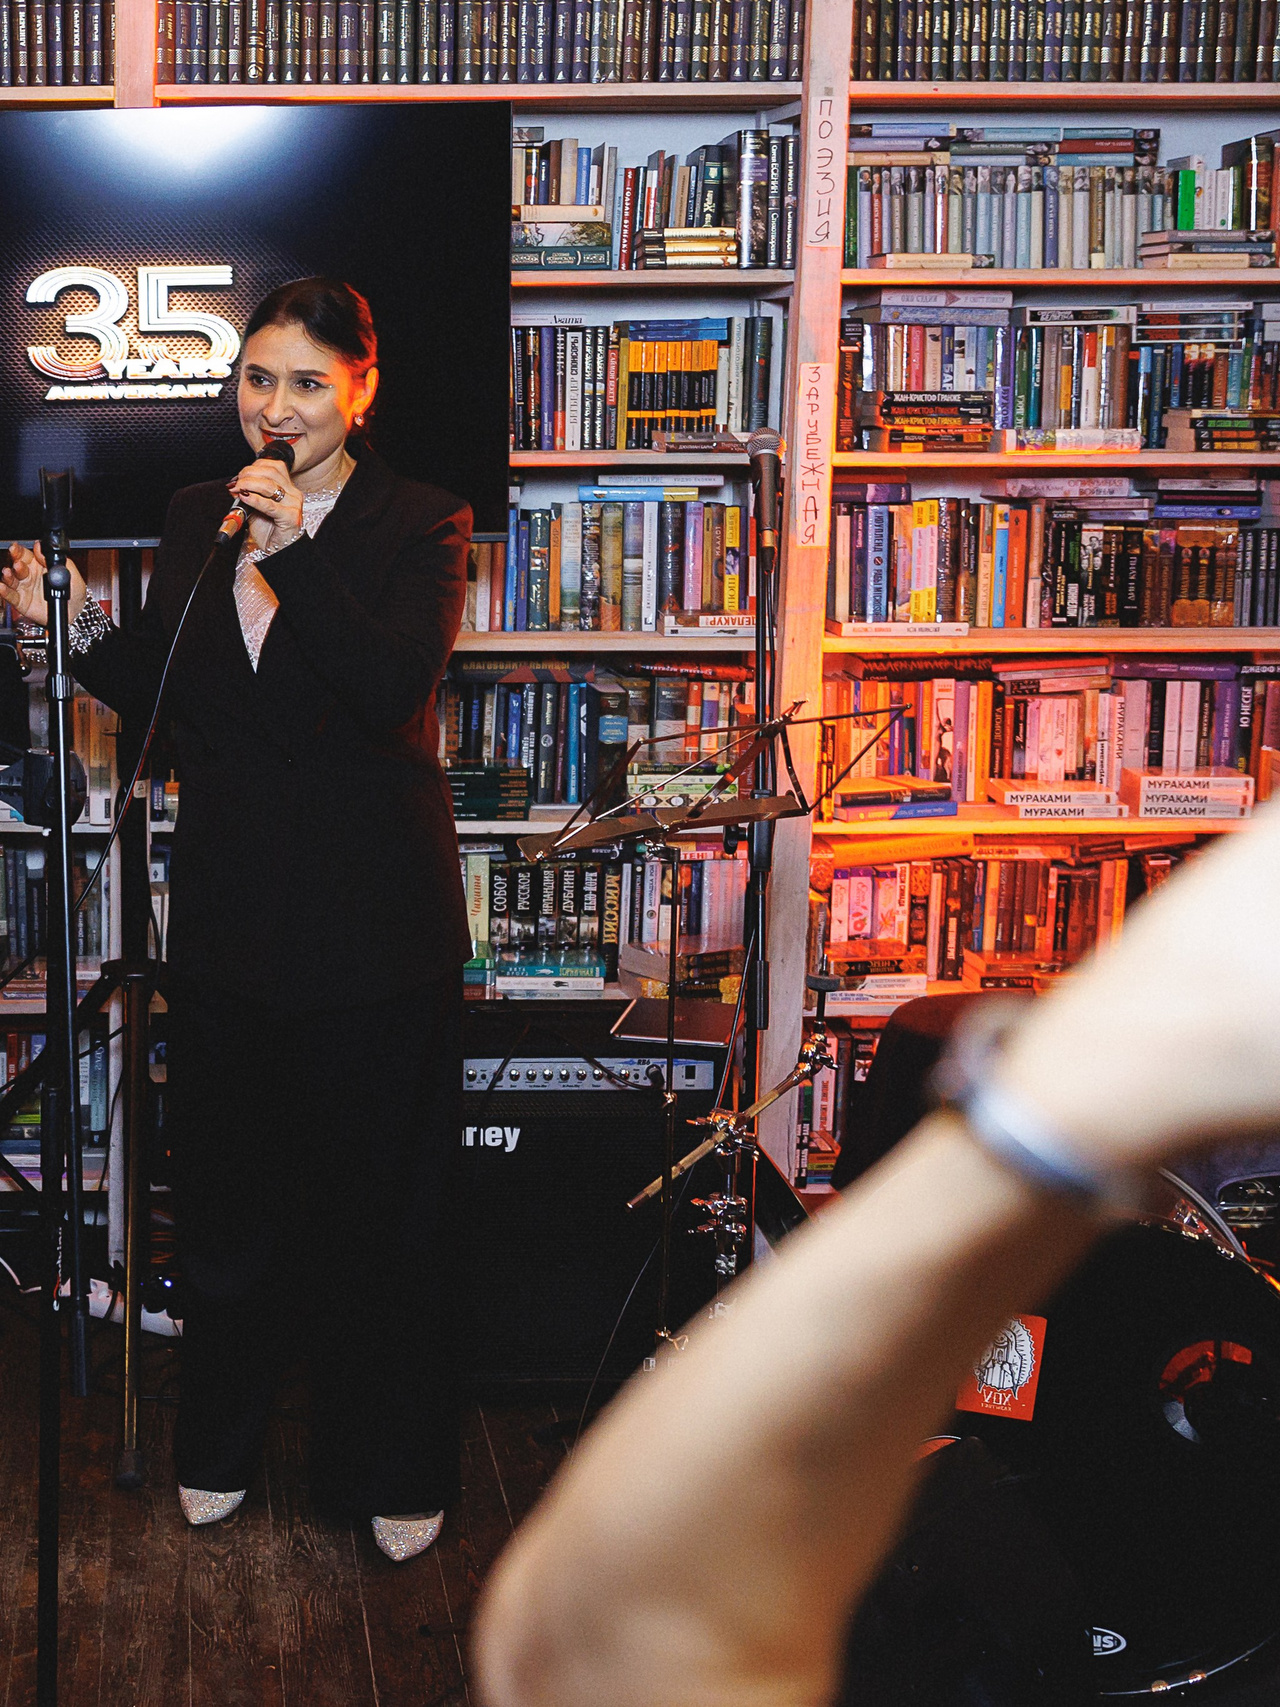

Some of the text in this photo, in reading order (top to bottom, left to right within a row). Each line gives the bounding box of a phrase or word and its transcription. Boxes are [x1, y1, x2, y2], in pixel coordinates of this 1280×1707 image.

[770, 163, 780, 193] ЕСЕНИН
[808, 100, 835, 243] ПОЭЗИЯ
[26, 265, 241, 380] 35
[101, 357, 232, 379] YEARS
[570, 336, 579, 375] СПОНСОРЫ
[44, 383, 223, 400] ANNIVERSARY
[609, 352, 618, 402] САЙМОН БЕКЕТТ
[891, 406, 934, 414] ЖАН-КРИСТОФ
[893, 393, 961, 402] ЖАН-КРИСТОФ ГРАНЖЕ
[893, 417, 962, 425] ЖАН-КРИСТОФ ГРАНЖЕ
[800, 366, 825, 544] ЗАРУБЕЖНАЯ
[1128, 556, 1137, 580] КУНЦ
[994, 707, 1003, 741] ДОРОГА
[1116, 701, 1125, 759] МУРАКАМИ
[1239, 716, 1250, 728] Ю
[1010, 794, 1071, 803] МУРАКАМИ
[1146, 794, 1208, 802] МУРАКАМИ
[1148, 780, 1210, 789] МУРАКАМИ
[1024, 808, 1084, 816] МУРАКАМИ
[1144, 807, 1205, 815] МУРАКАМИ
[470, 875, 483, 917] Чикита
[493, 875, 507, 912] СОБОР
[517, 872, 530, 911] РУССКОЕ
[542, 870, 555, 915] ИРЛАНДИЯ
[562, 870, 574, 913] ДУБЛИН
[583, 871, 597, 911] НЬЮ-ЙОРК
[602, 874, 621, 945] МИССИЯ
[983, 1389, 1012, 1406] VOX
